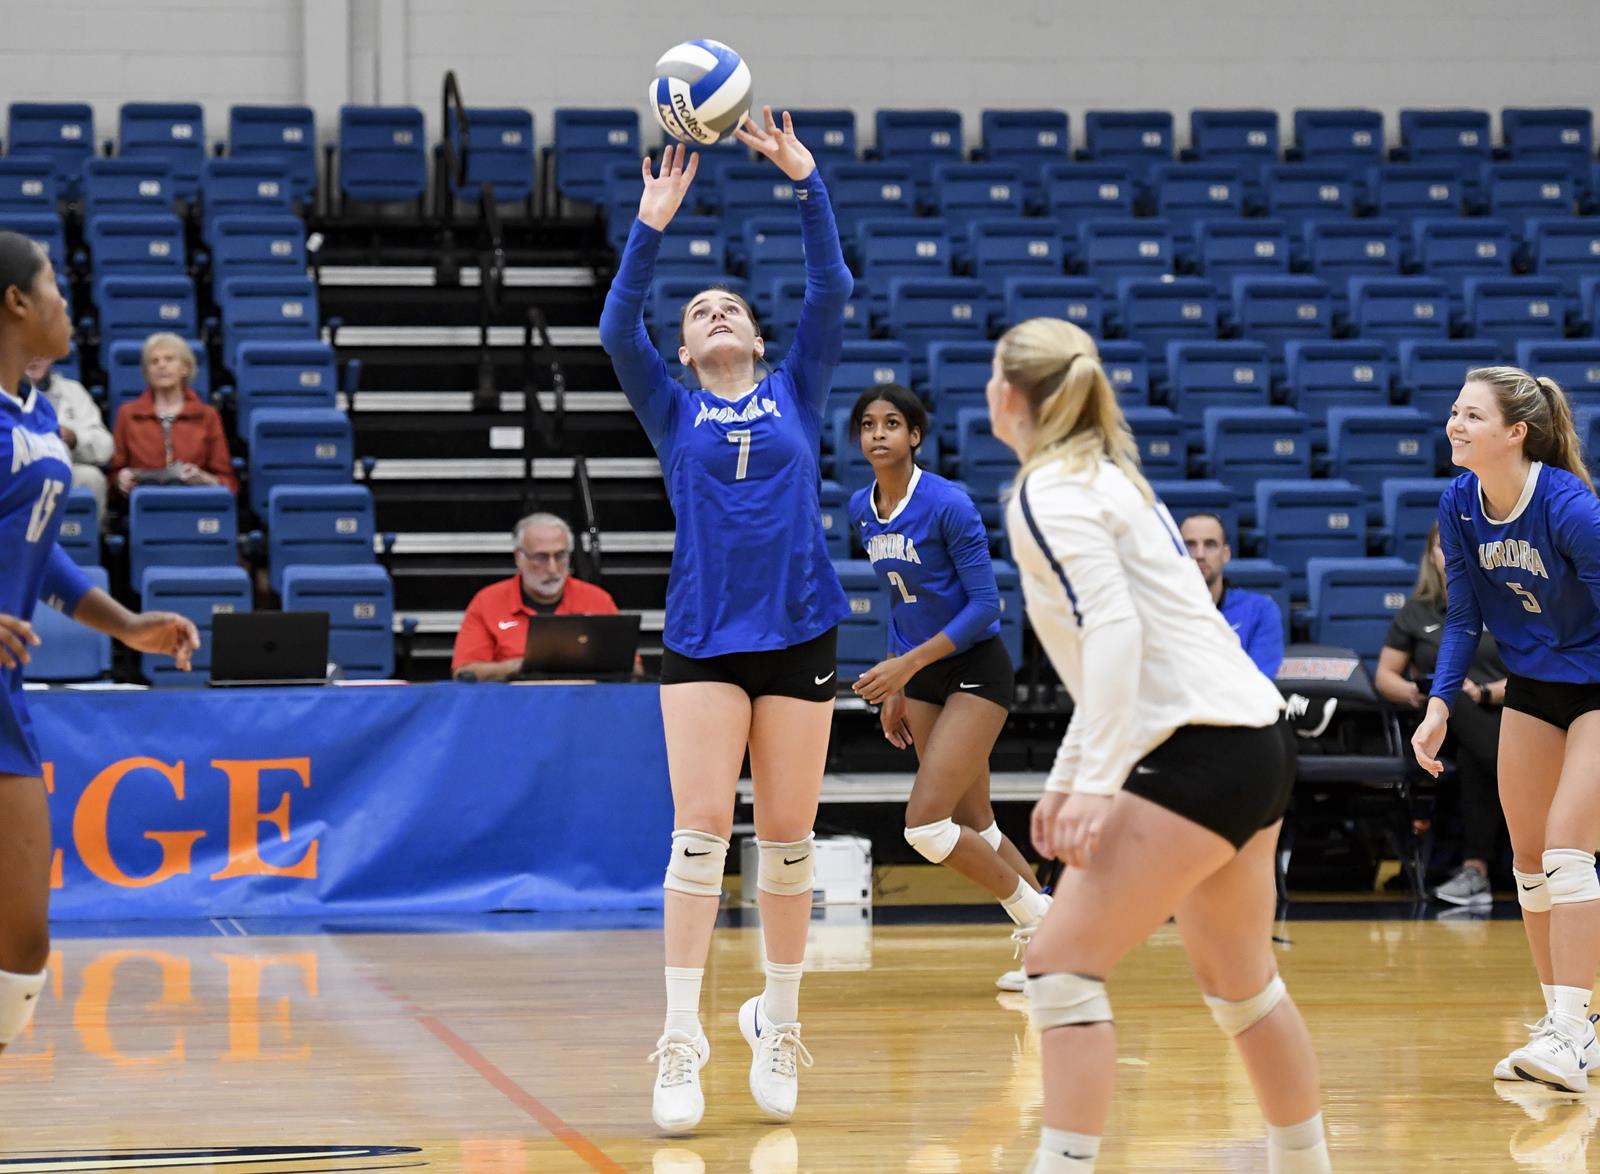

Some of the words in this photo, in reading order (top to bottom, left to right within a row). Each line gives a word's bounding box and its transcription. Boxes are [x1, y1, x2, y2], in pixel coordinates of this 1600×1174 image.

[673, 93, 708, 140] molten
[726, 429, 751, 480] 7
[887, 571, 918, 604] 2
[1506, 582, 1542, 614] 5
[42, 756, 319, 889] GE
